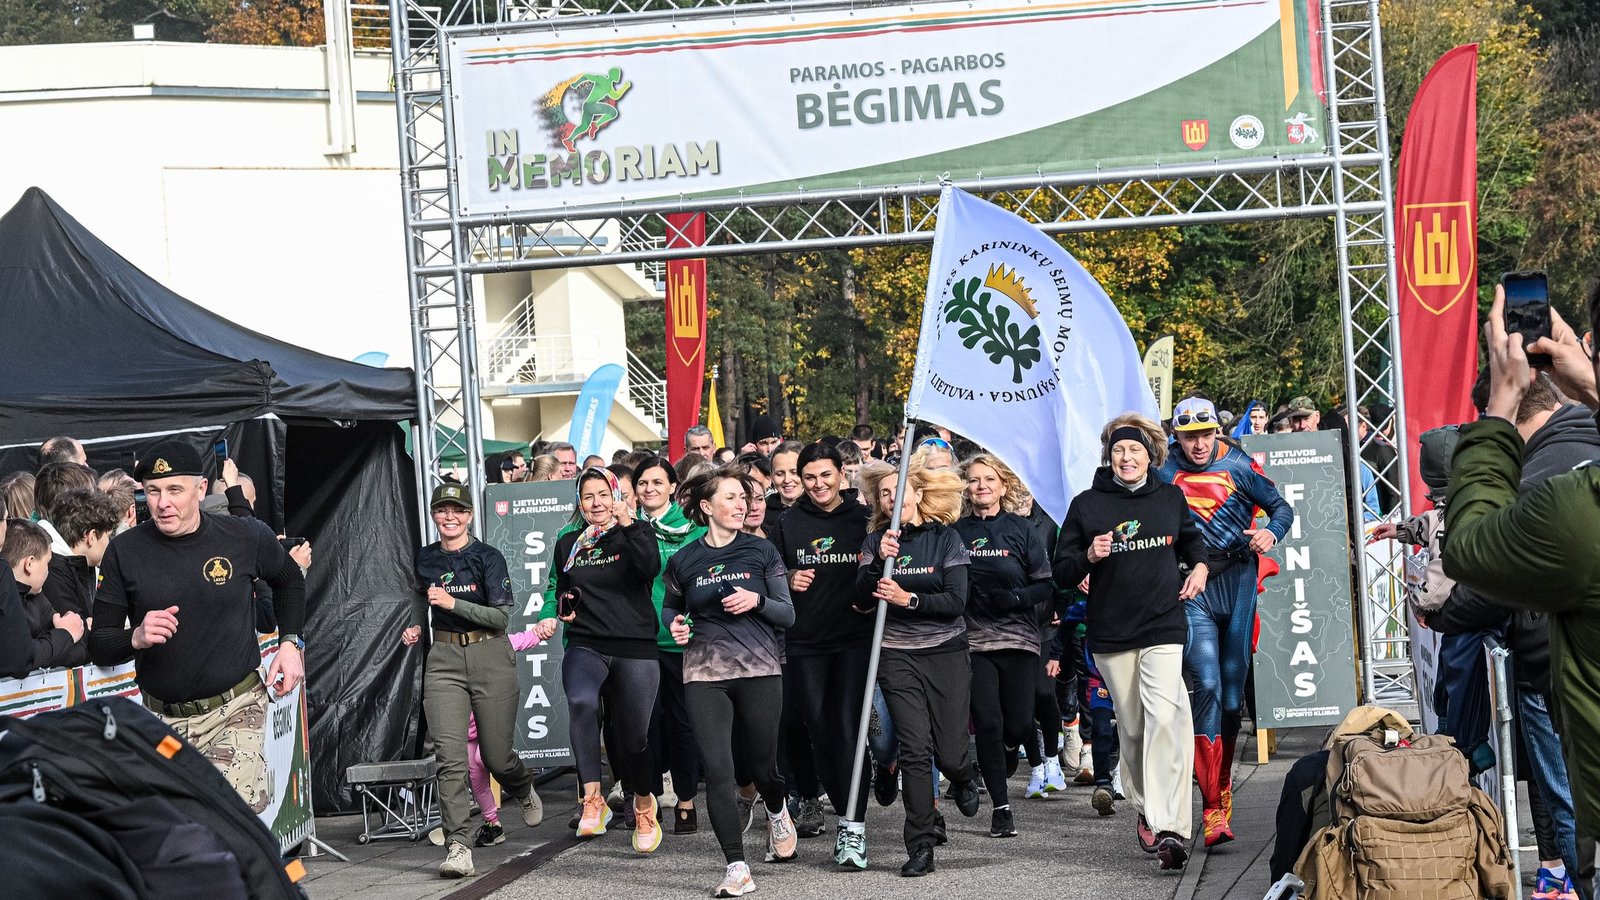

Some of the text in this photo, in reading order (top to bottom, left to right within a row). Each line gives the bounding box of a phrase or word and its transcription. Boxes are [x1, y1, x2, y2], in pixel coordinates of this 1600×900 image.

[789, 61, 885, 83] PARAMOS
[900, 52, 1006, 75] PAGARBOS
[796, 79, 1005, 130] BĖGIMAS
[487, 128, 519, 156] IN
[487, 139, 720, 192] MEMORIAM
[959, 240, 1053, 267] KARININKŲ
[1049, 268, 1073, 319] ŠEIMŲ
[930, 373, 975, 401] LIETUVA
[989, 378, 1057, 403] SĄJUNGA
[1269, 449, 1317, 459] LIETUVOS
[1270, 454, 1333, 466] KARIUOMENĖ
[513, 497, 558, 507] LIETUVOS
[513, 503, 574, 515] KARIUOMENĖ
[796, 548, 805, 556] IN
[1111, 535, 1166, 553] EMORIAM
[797, 553, 857, 565] MEMORIAM
[967, 549, 1003, 557] MORIAM
[891, 566, 928, 575] EMORIAM
[696, 572, 745, 587] MEMORIAM
[445, 584, 471, 593] ORIAM
[1284, 483, 1319, 698] FINIŠAS
